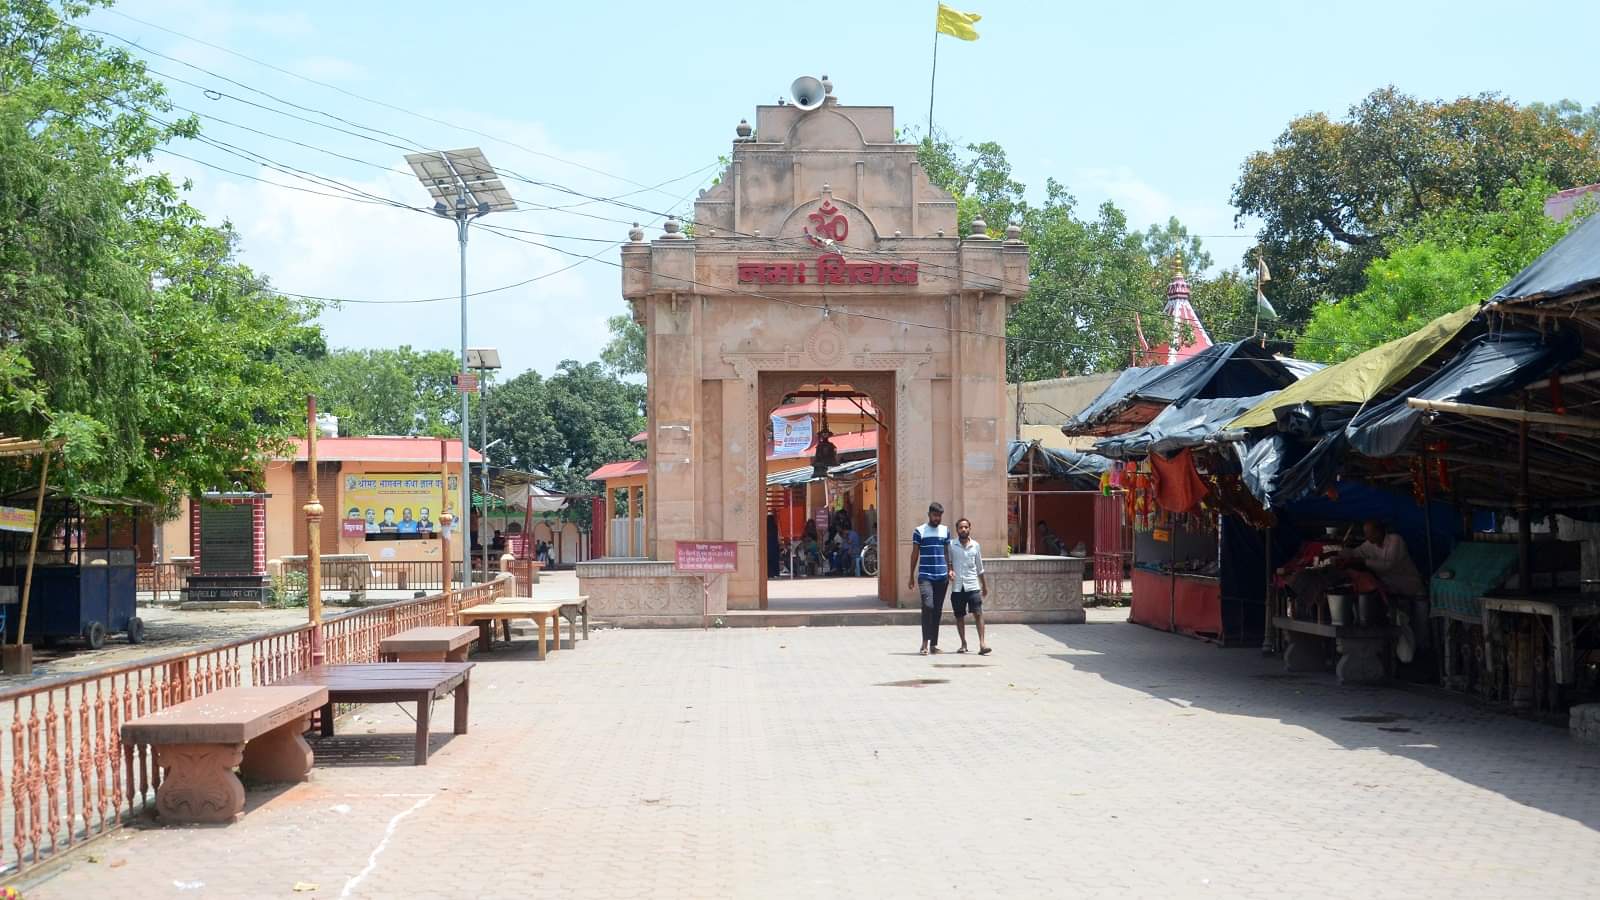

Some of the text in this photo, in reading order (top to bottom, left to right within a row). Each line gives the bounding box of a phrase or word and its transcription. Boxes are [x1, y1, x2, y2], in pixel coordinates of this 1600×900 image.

[738, 253, 919, 287] नमः शिवाय
[243, 590, 259, 598] CITY
